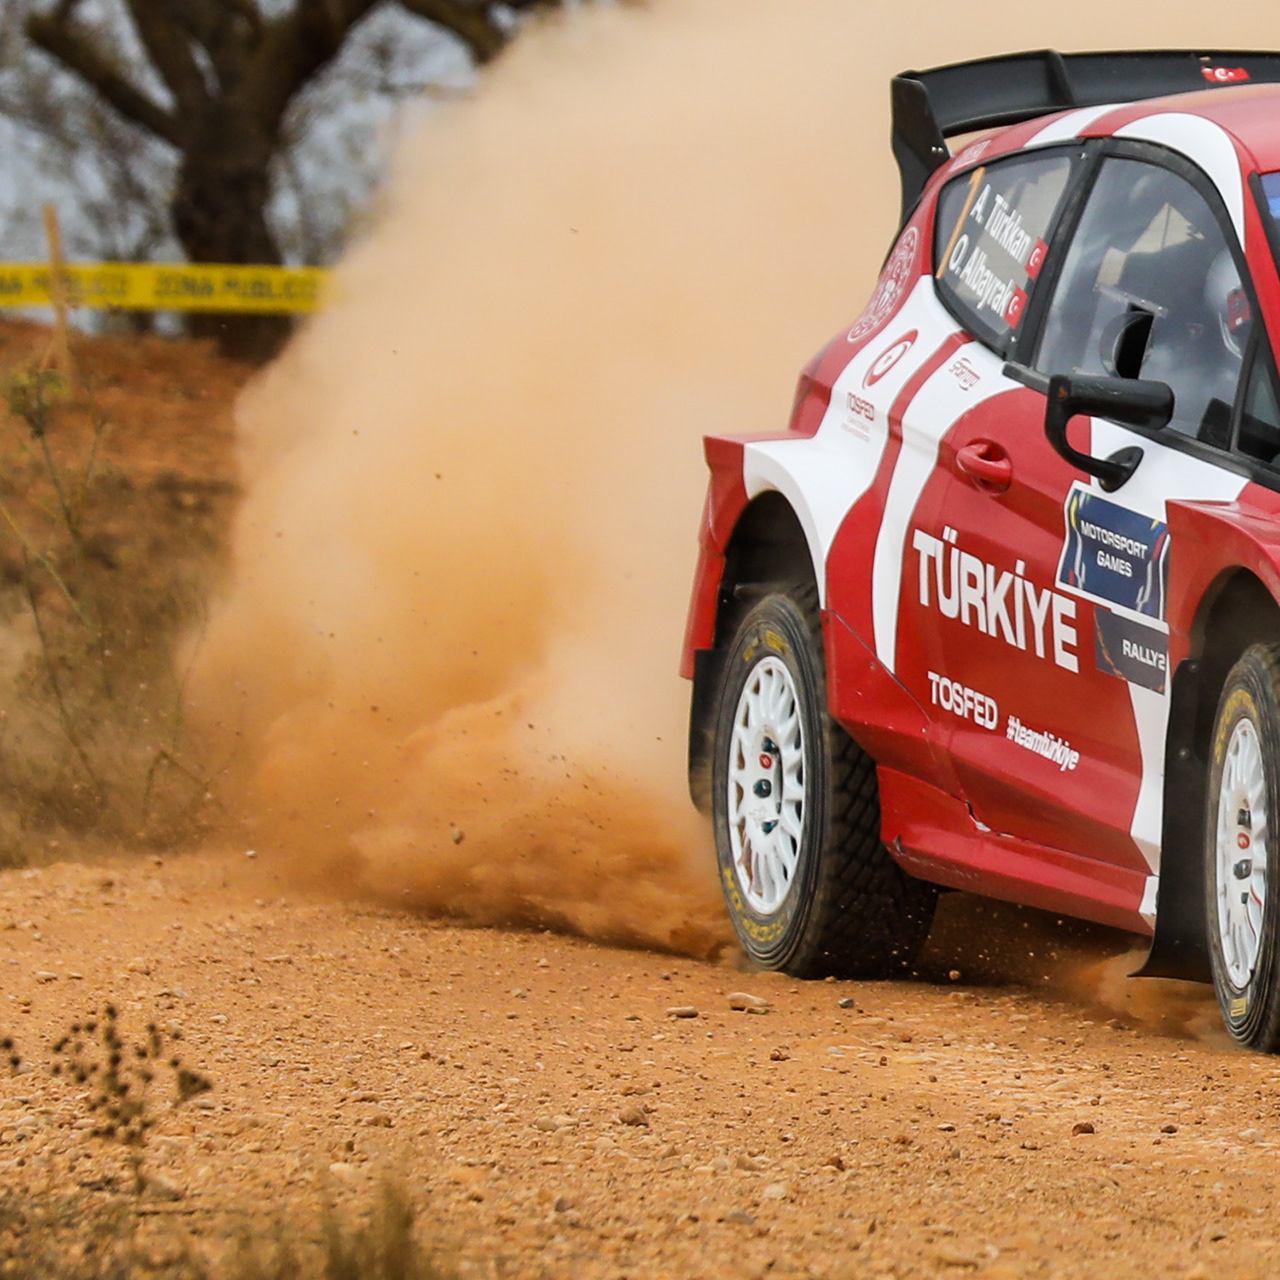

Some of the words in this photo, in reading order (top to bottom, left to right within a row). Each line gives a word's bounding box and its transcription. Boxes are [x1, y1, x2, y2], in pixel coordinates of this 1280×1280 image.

[970, 183, 991, 224] A.
[984, 193, 1032, 264] Türkkan
[948, 234, 970, 276] O.
[959, 246, 1015, 317] Albayrak
[1080, 519, 1149, 561] MOTORSPORT
[1096, 550, 1133, 578] GAMES
[912, 525, 1080, 674] TÜRKİYE
[1122, 638, 1167, 671] RALLY2
[927, 670, 998, 731] TOSFED
[1006, 714, 1081, 772] #teamtürkiye
